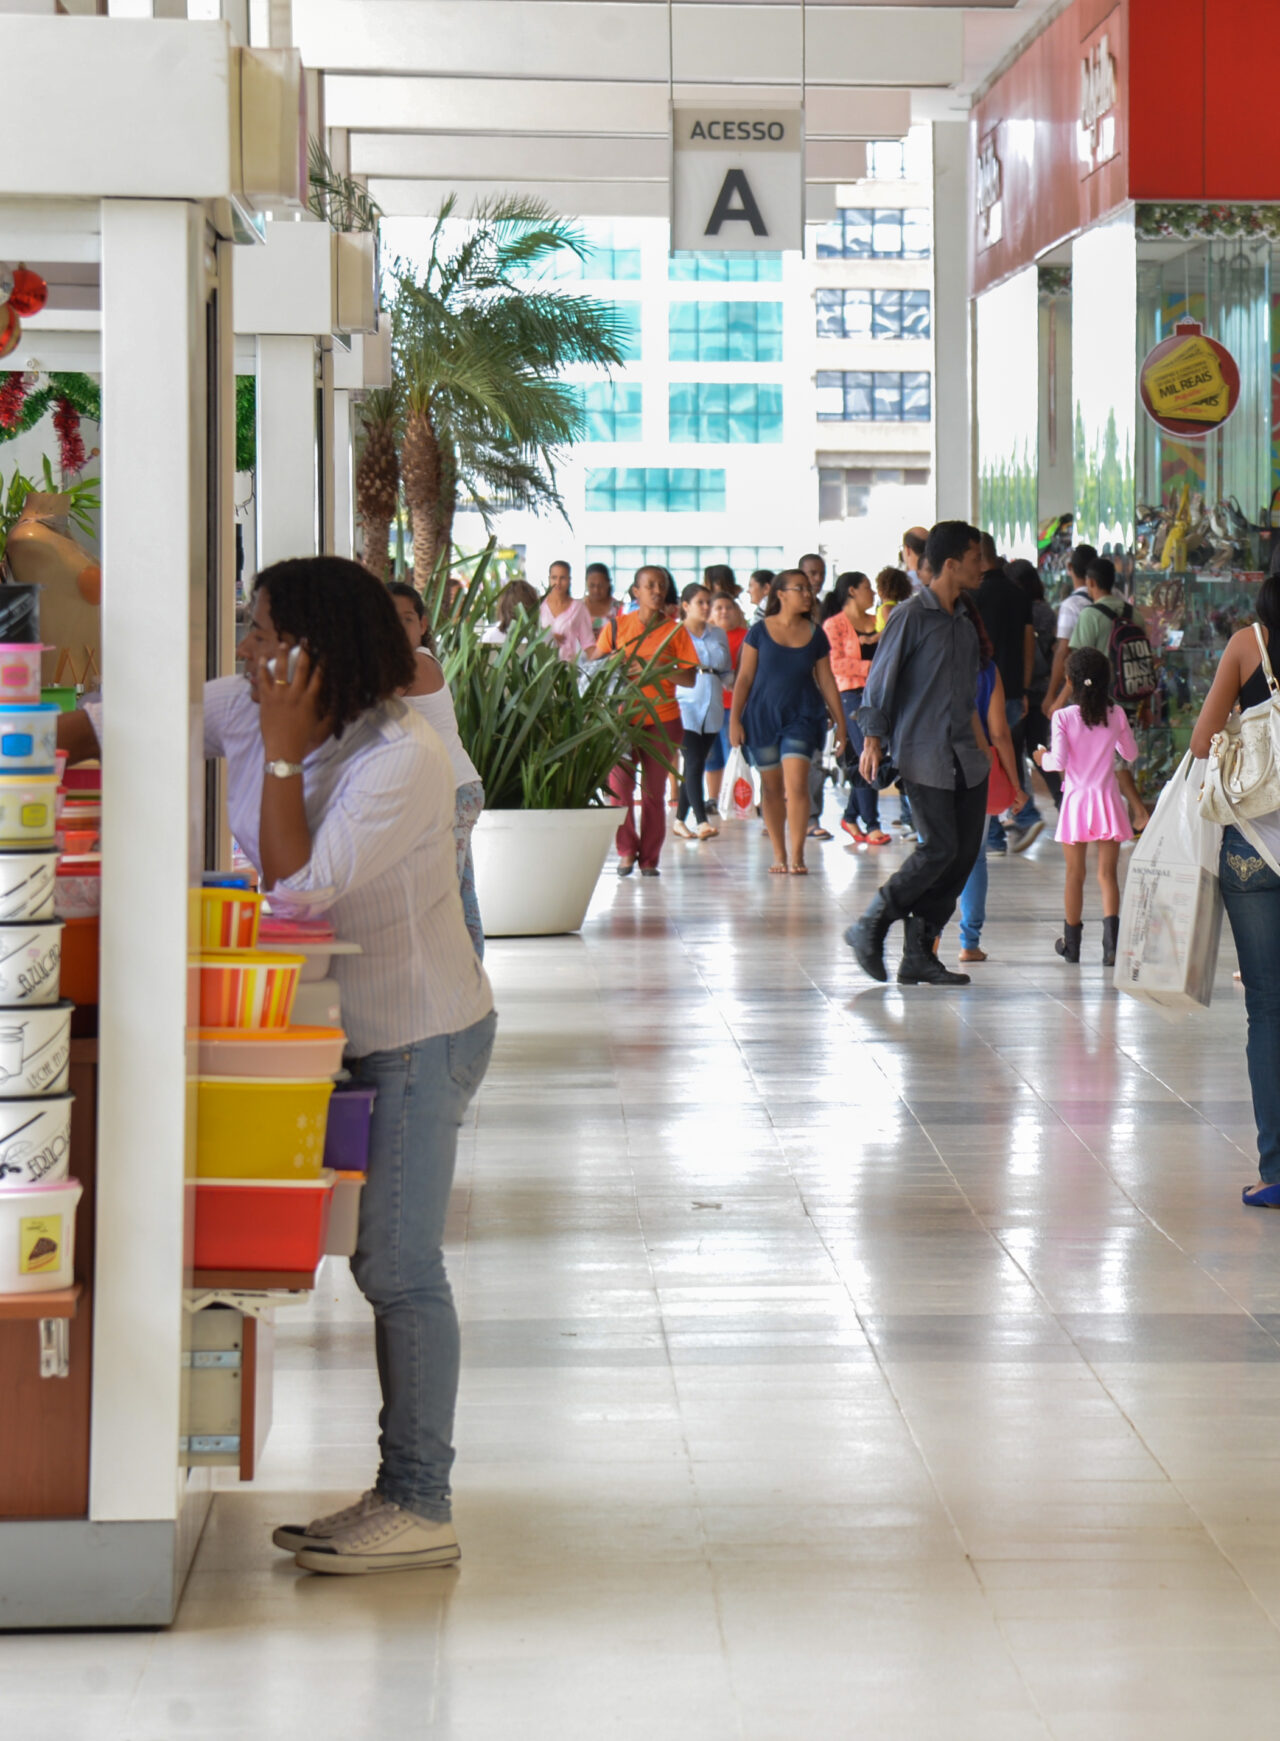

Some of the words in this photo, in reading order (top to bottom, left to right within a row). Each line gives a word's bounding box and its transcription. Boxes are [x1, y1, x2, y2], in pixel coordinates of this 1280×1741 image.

[690, 120, 785, 141] ACESSO
[704, 168, 769, 237] A
[1159, 382, 1181, 399] MIL
[1180, 370, 1213, 390] REAIS
